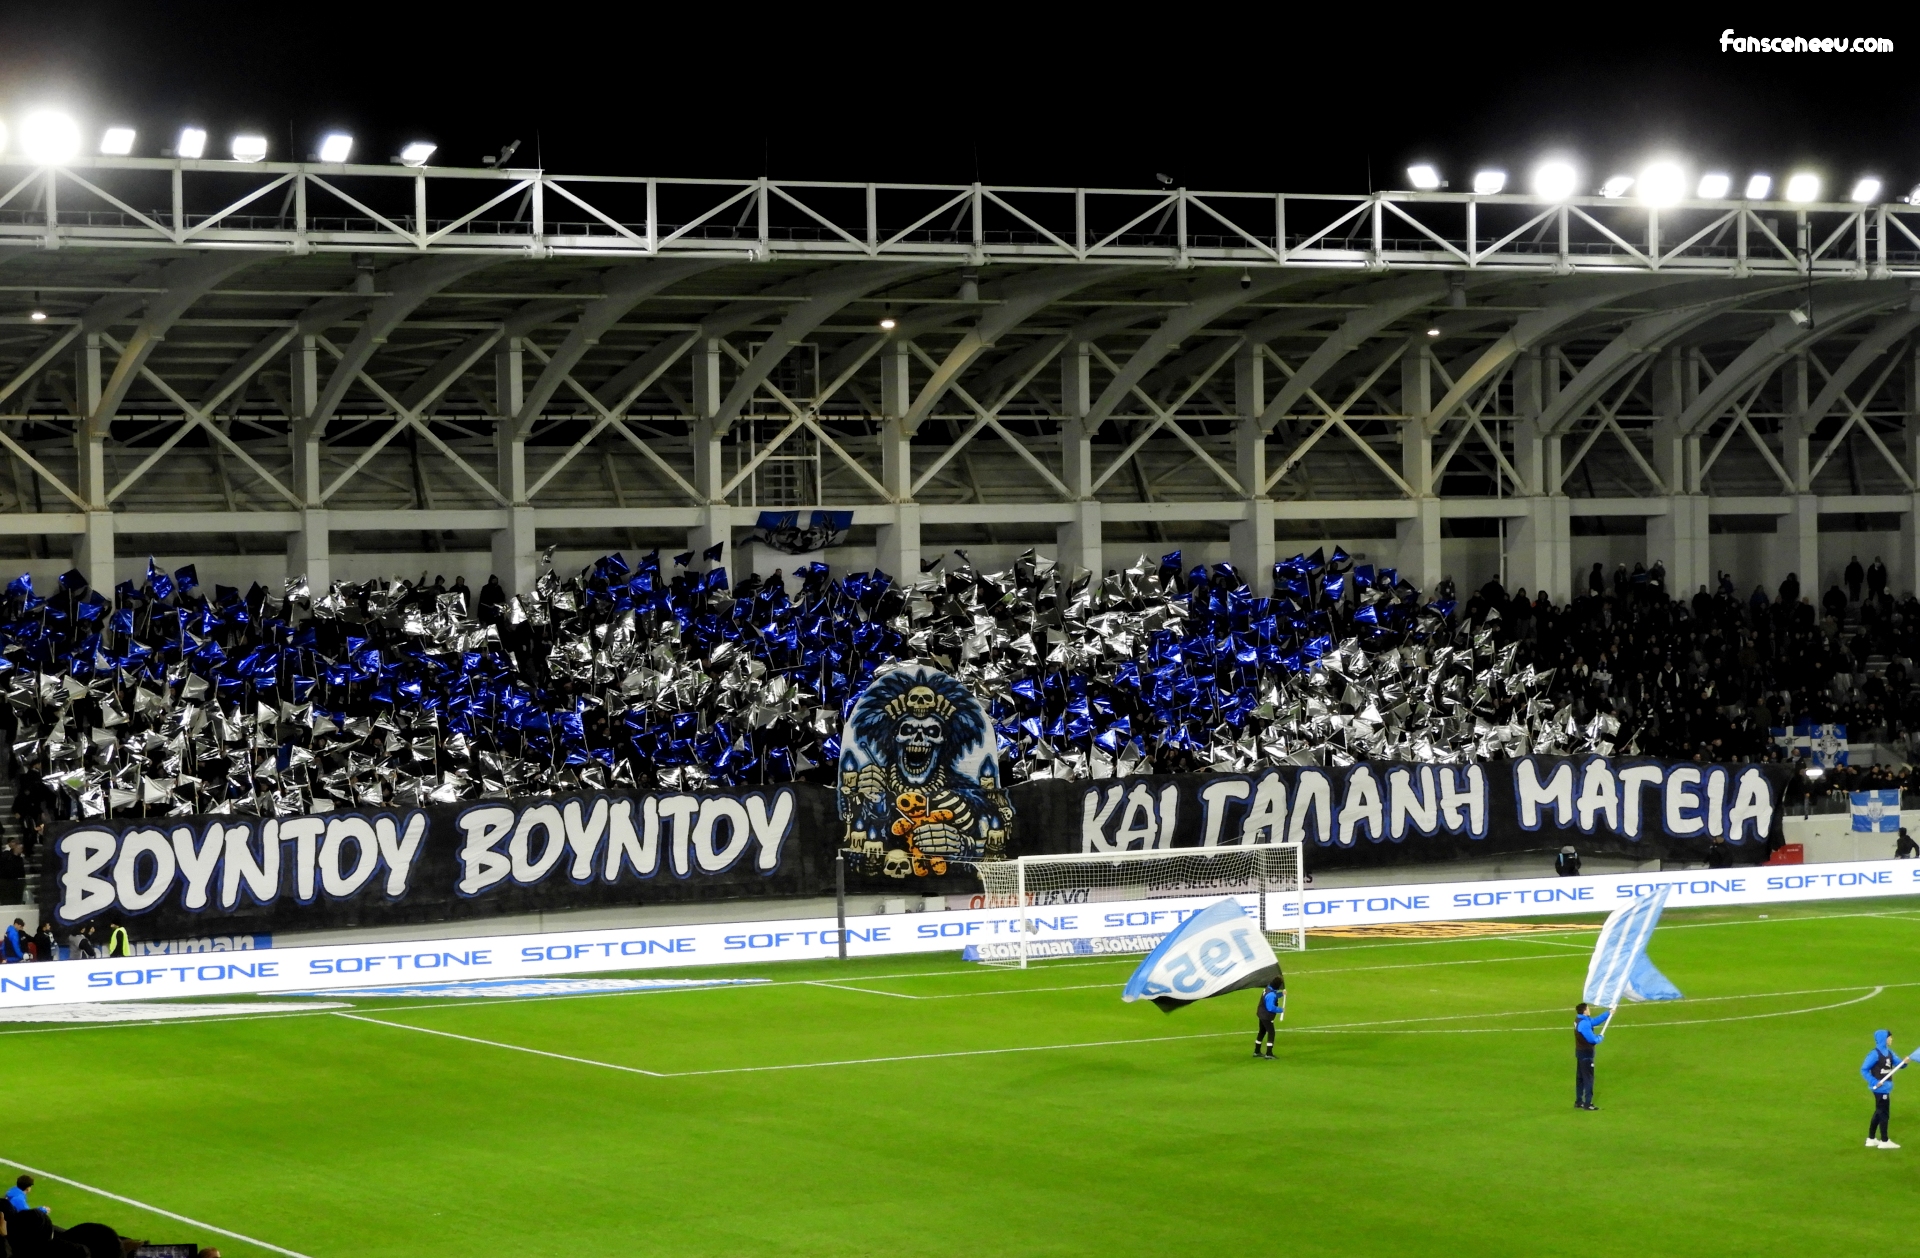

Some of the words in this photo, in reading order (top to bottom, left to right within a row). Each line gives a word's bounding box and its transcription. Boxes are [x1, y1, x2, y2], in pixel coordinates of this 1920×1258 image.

[58, 812, 427, 922] ΒΟΥΝΤΟΥ
[458, 790, 794, 896] ΒΟΥΝΤΟΥ
[1081, 783, 1179, 860] ΚΑΙ
[1201, 764, 1486, 850] ΓΑΛΑΝΗ
[1516, 758, 1774, 842] ΜΑΓΕΙΑ
[1767, 870, 1893, 889] SOFTONE
[1282, 895, 1430, 917] SOFTONE
[1453, 886, 1595, 907] SOFTONE
[1104, 901, 1258, 928] SOFTE
[521, 937, 696, 962] SOFTONE
[724, 926, 892, 950] SOFTONE
[1090, 933, 1164, 955] Stoixim
[309, 949, 493, 975] SOFTONE
[87, 961, 279, 988] SOFTONE
